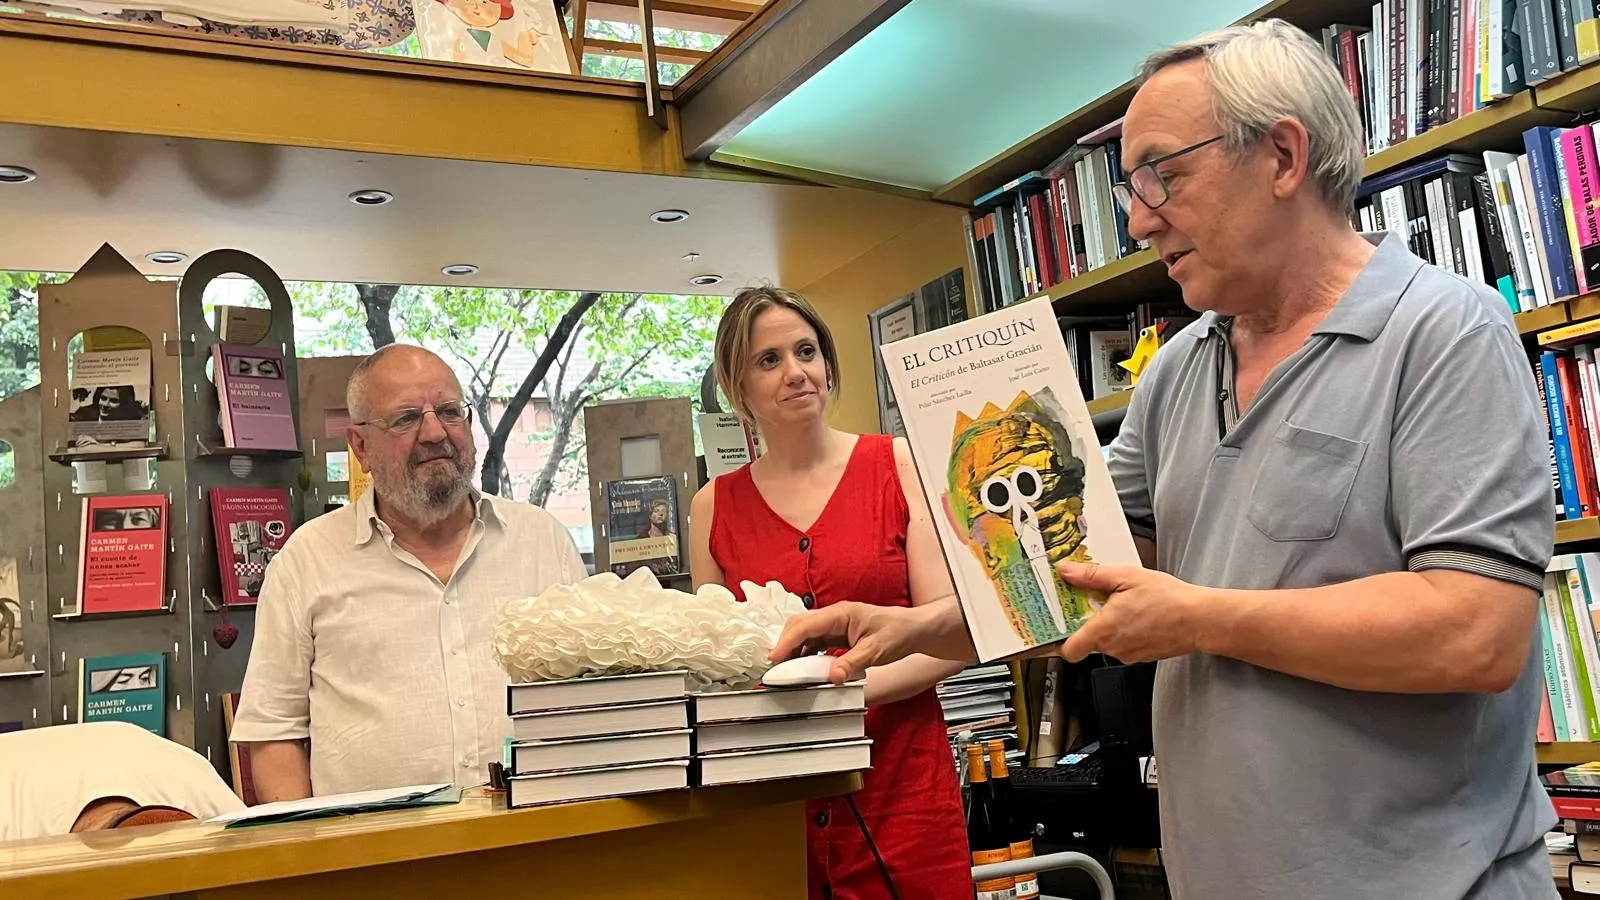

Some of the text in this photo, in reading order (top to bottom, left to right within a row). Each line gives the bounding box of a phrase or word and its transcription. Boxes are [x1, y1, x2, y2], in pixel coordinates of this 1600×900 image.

[1573, 135, 1588, 176] PERDIDAS
[1559, 168, 1567, 179] del
[1581, 177, 1593, 205] BALAS
[1586, 203, 1594, 216] DE
[902, 353, 926, 371] EL
[928, 317, 1036, 362] CRITIQUÍN
[910, 343, 1043, 389] El Criticón de Baltasar Gracián
[1008, 374, 1020, 383] José
[1020, 371, 1033, 380] Luis
[229, 382, 260, 390] CARMEN
[260, 390, 283, 398] GAITE
[918, 401, 932, 410] Pilar
[933, 394, 956, 407] Sánchez
[222, 503, 250, 511] PÁGINAS
[90, 537, 129, 546] CARMEN
[127, 543, 155, 552] GAITE
[1544, 648, 1557, 696] Homo Solver
[1556, 643, 1572, 709] Hábitos atómicos
[88, 699, 126, 709] CARMEN
[88, 704, 153, 716] MARTÍN GAITE
